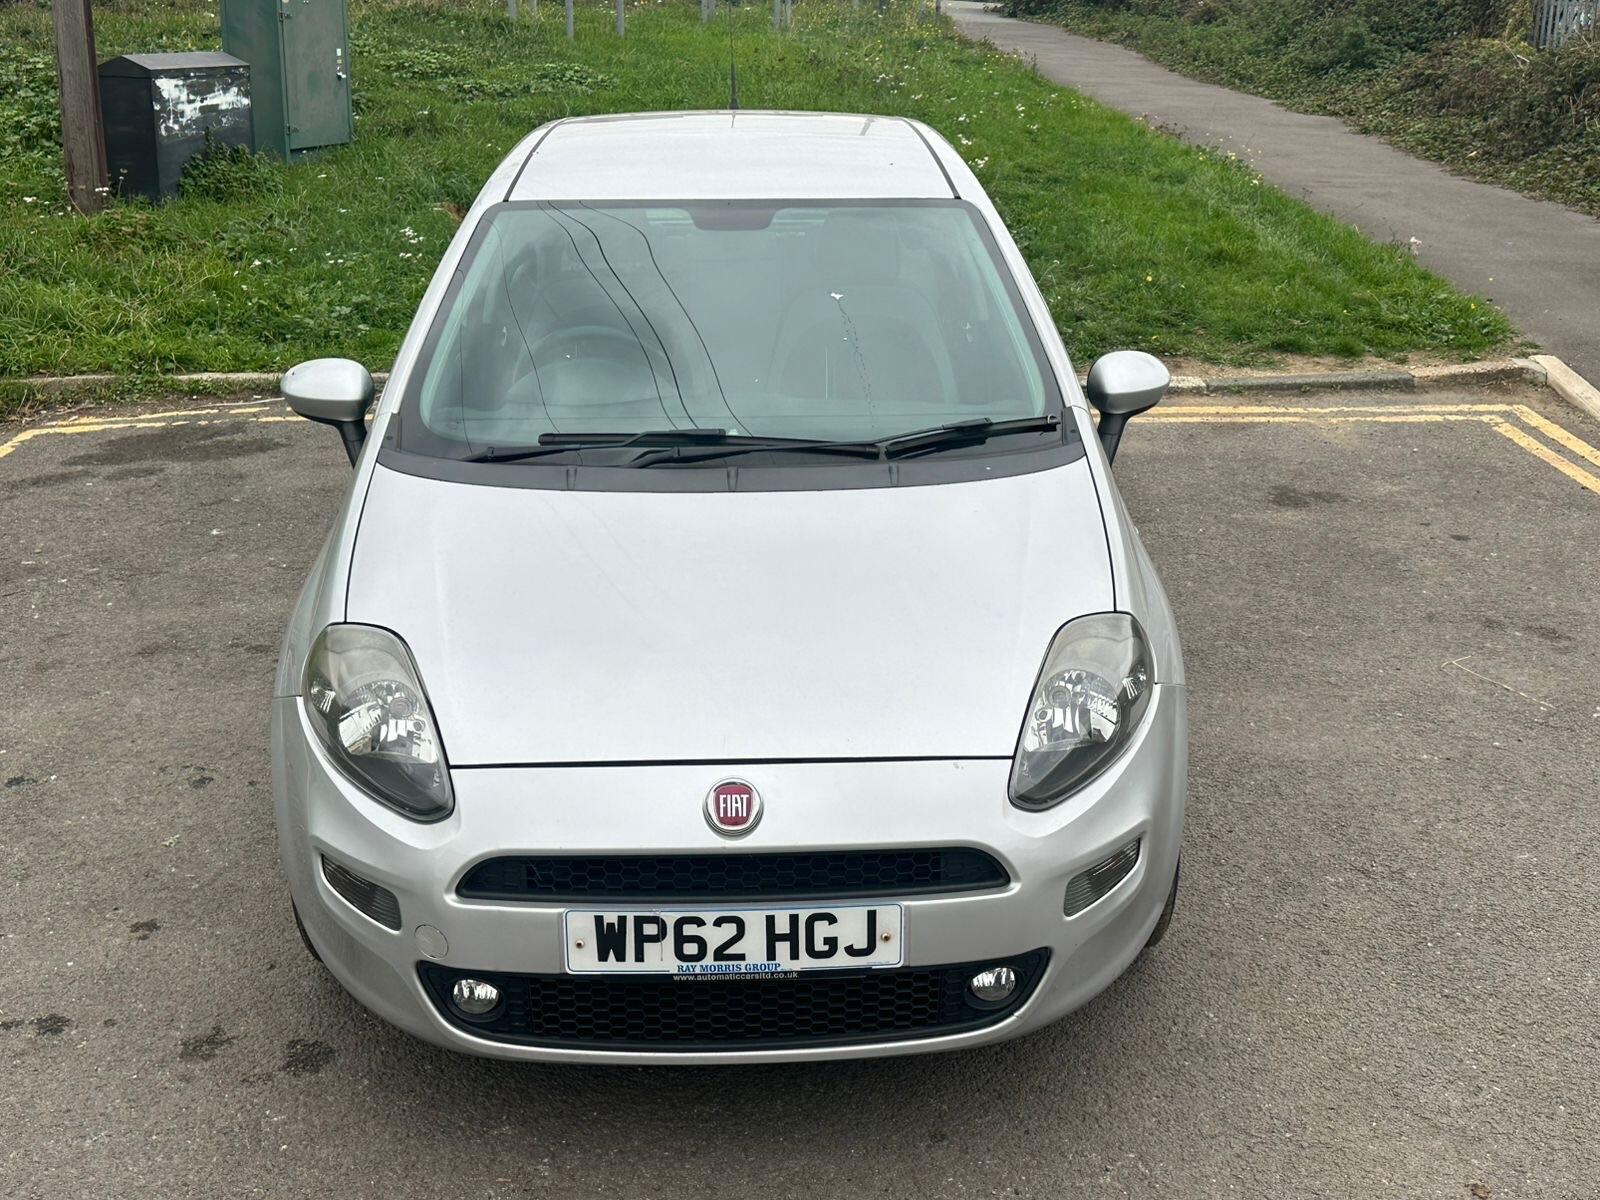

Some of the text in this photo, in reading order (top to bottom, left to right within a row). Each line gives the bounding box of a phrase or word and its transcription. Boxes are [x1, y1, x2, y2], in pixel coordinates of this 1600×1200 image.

[719, 794, 749, 817] FIAT
[594, 909, 877, 962] WP62 HGJ
[673, 971, 798, 981] www.automaticcarsltd.co.uk
[677, 964, 697, 973] RAY
[699, 963, 741, 973] MORRIS
[744, 963, 781, 972] GROUP
